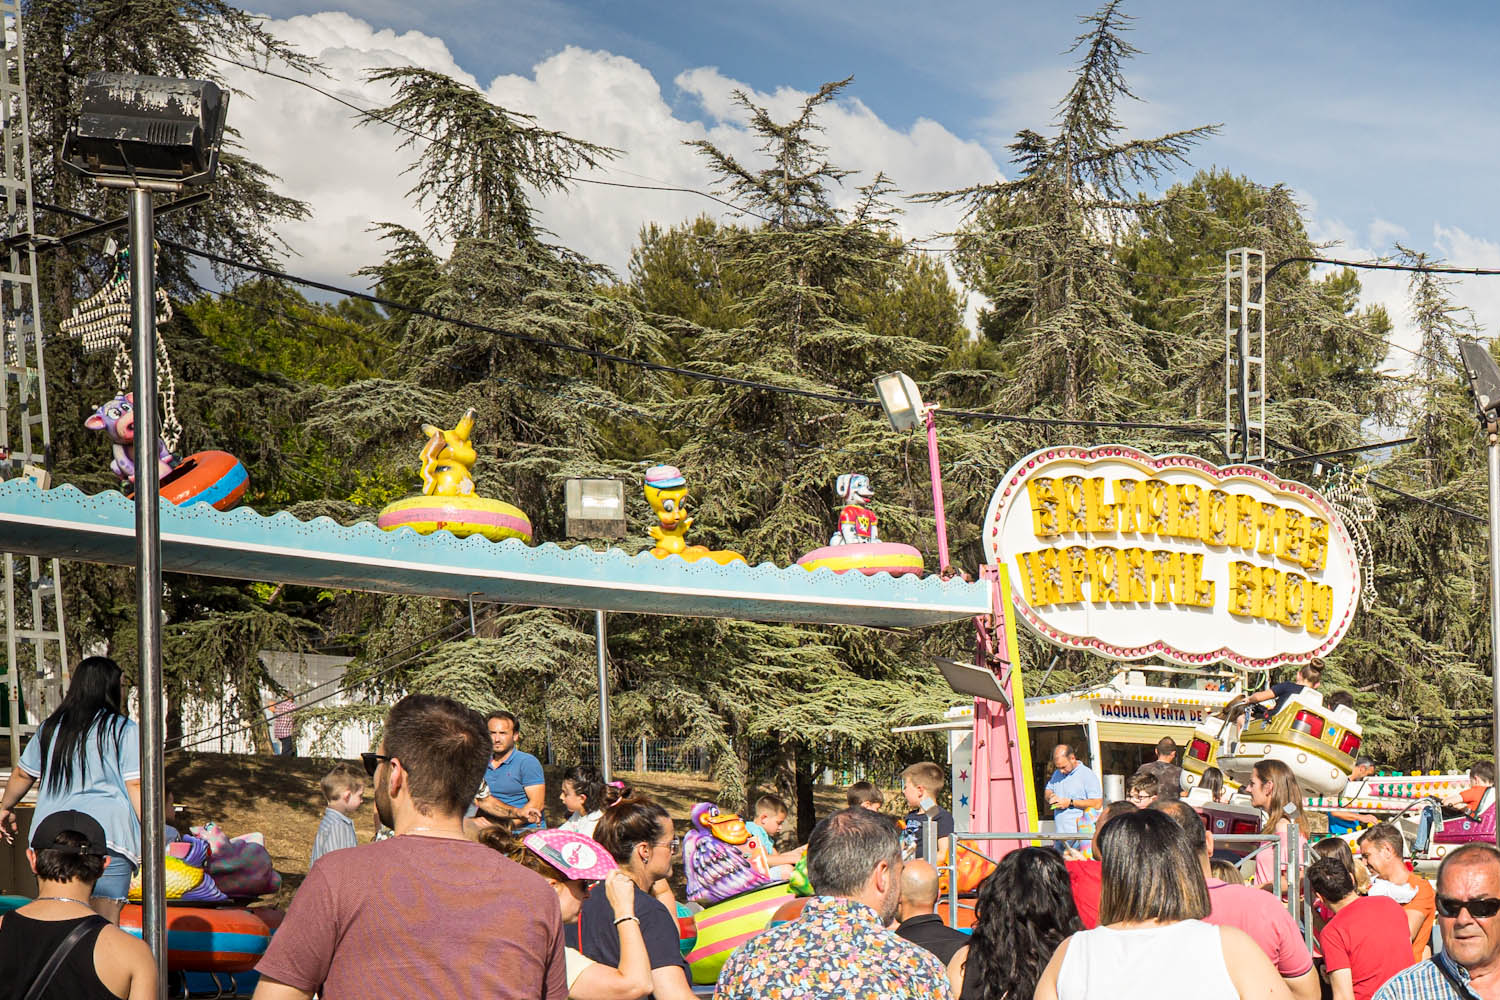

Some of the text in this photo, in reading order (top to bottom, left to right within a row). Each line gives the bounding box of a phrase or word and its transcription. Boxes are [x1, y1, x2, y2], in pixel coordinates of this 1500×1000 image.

[1016, 545, 1215, 608] INFANTIL
[1100, 703, 1202, 721] TAQUILLA VENTA DE
